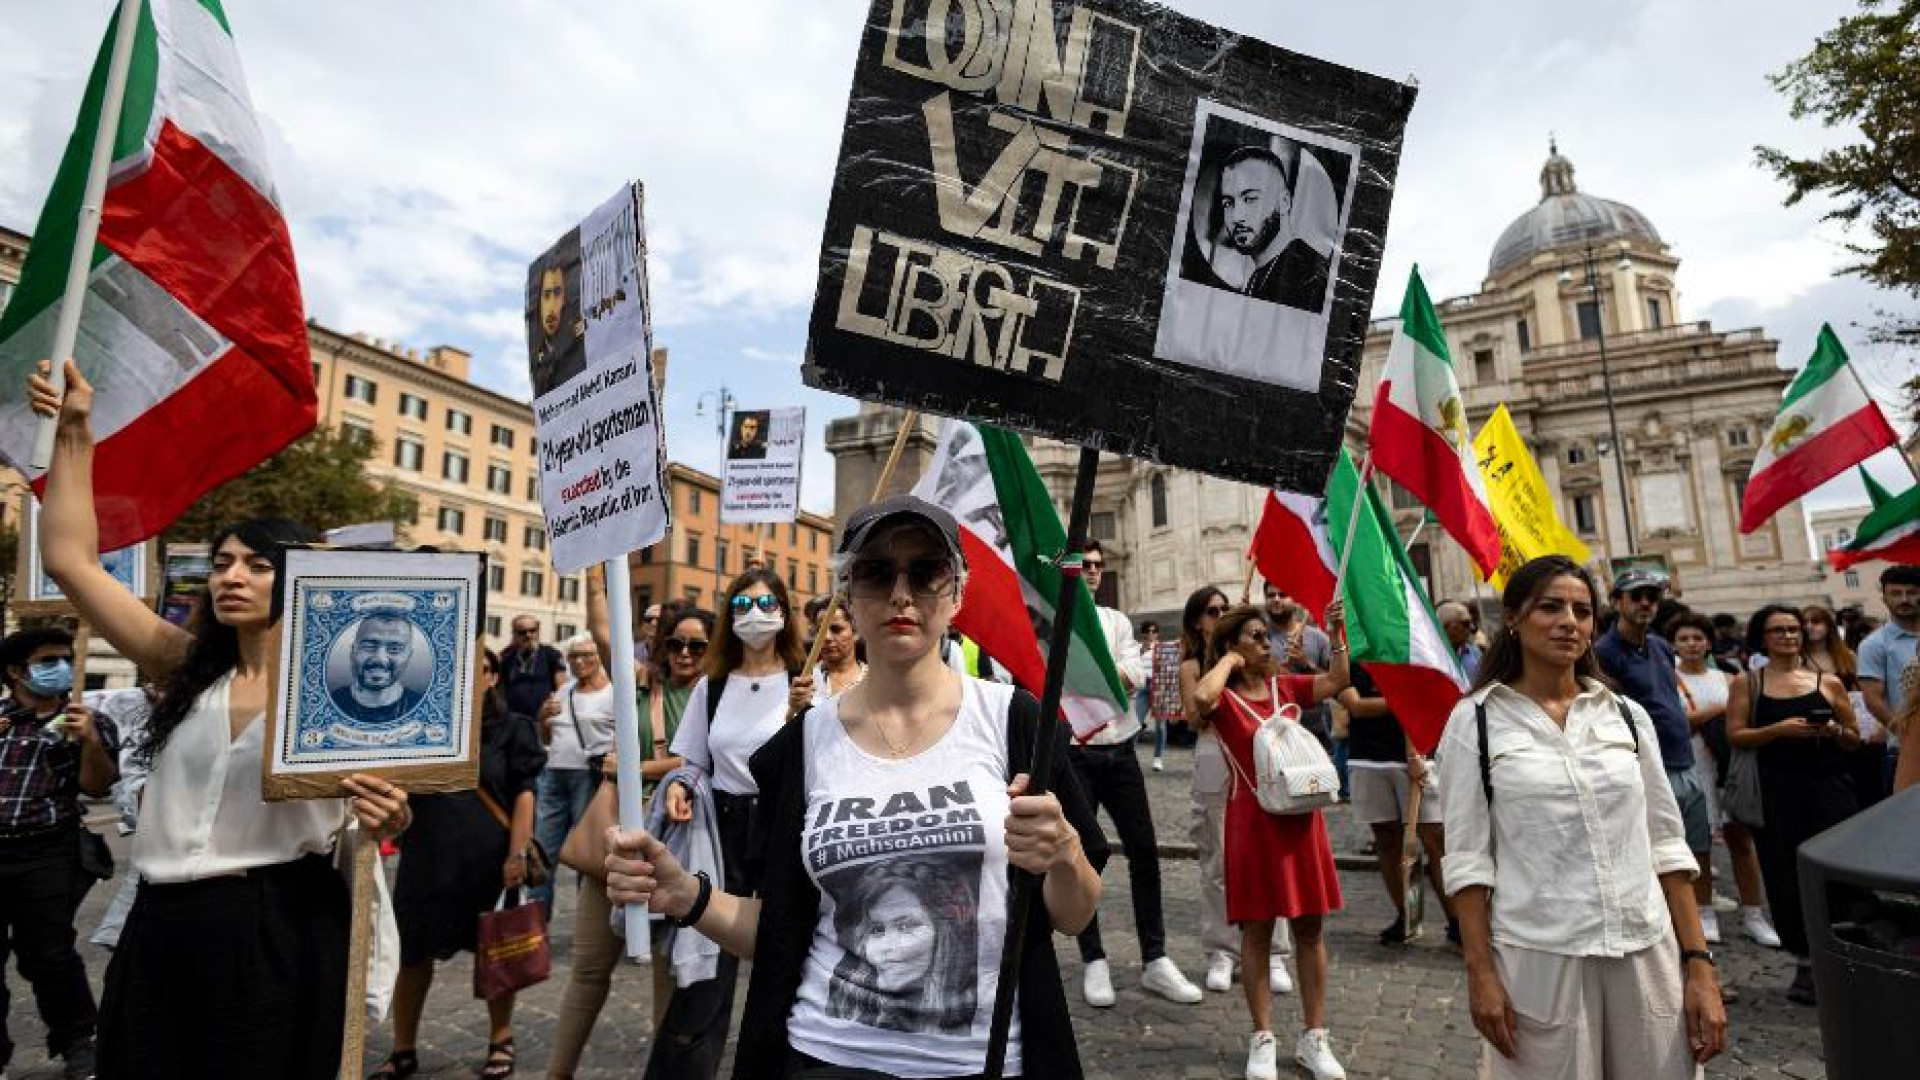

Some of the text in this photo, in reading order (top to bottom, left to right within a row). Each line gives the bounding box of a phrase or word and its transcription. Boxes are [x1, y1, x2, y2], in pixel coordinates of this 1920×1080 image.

[921, 90, 1139, 270] VITA
[592, 400, 649, 453] sportsman
[808, 807, 982, 850] FREEDOM
[812, 780, 976, 829] IRAN
